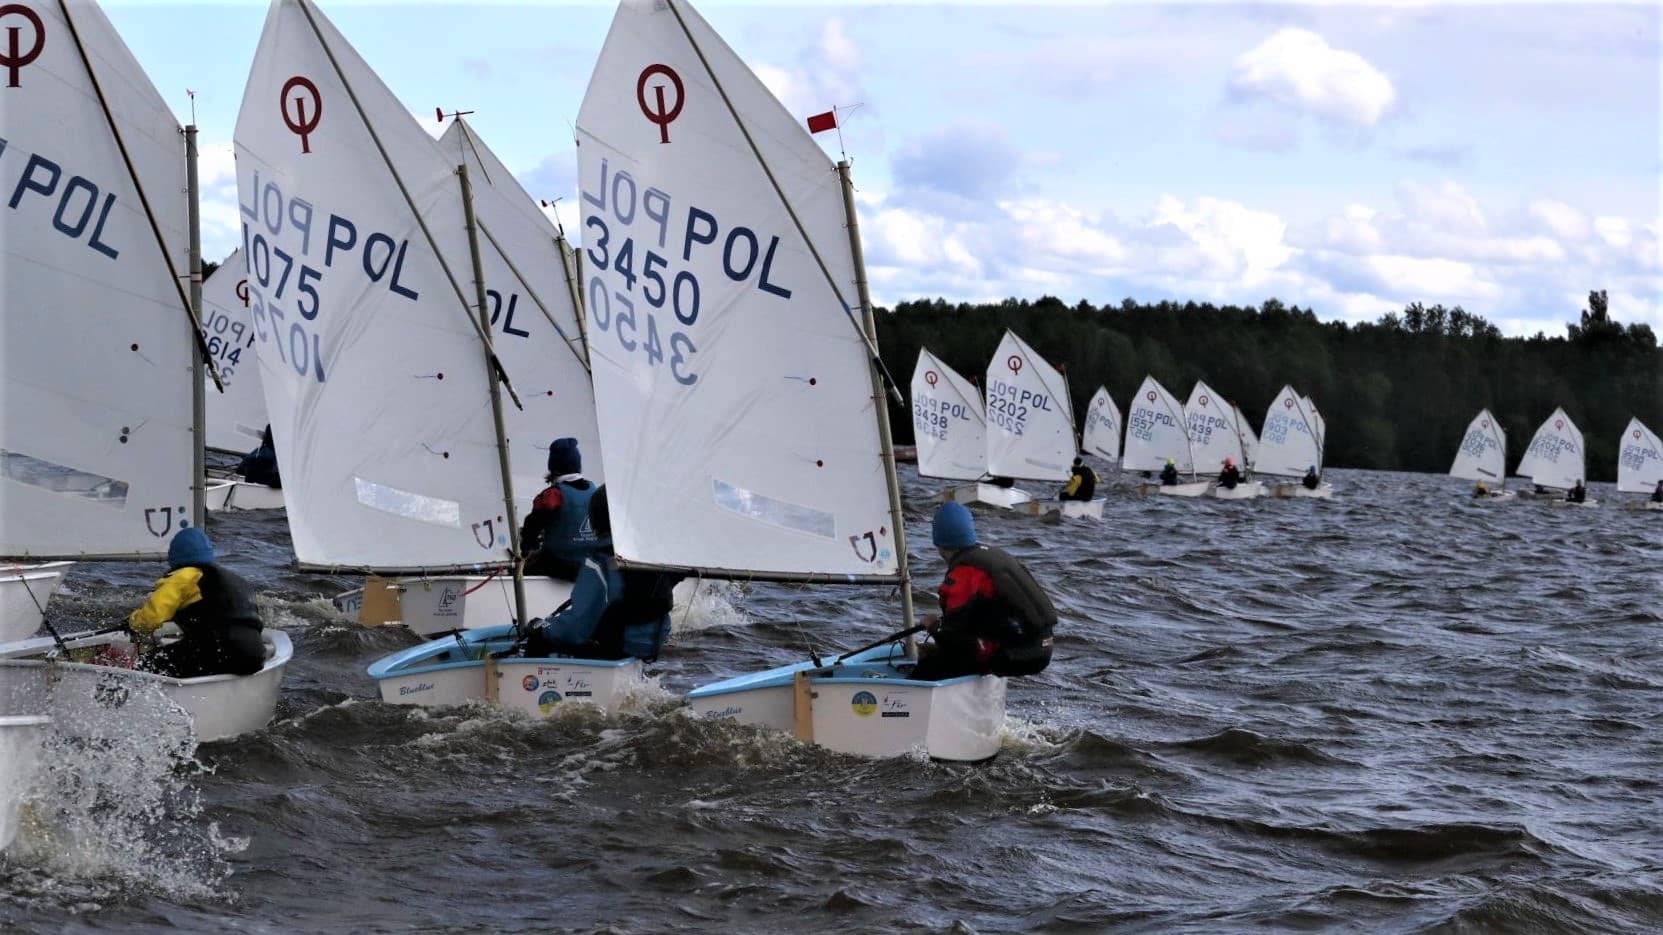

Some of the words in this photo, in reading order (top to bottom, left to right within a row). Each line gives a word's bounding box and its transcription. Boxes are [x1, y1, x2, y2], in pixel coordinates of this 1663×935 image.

[8, 153, 119, 260] POL
[325, 213, 419, 301] POL
[682, 206, 792, 299] POL
[243, 222, 322, 320] 1075
[586, 215, 700, 326] 3450
[941, 402, 970, 421] POL
[989, 394, 1027, 422] 2202
[1020, 390, 1052, 411] POL
[915, 404, 948, 429] 3438
[1130, 416, 1155, 432] 1557
[1155, 413, 1176, 427] POL
[1207, 416, 1228, 430] POL
